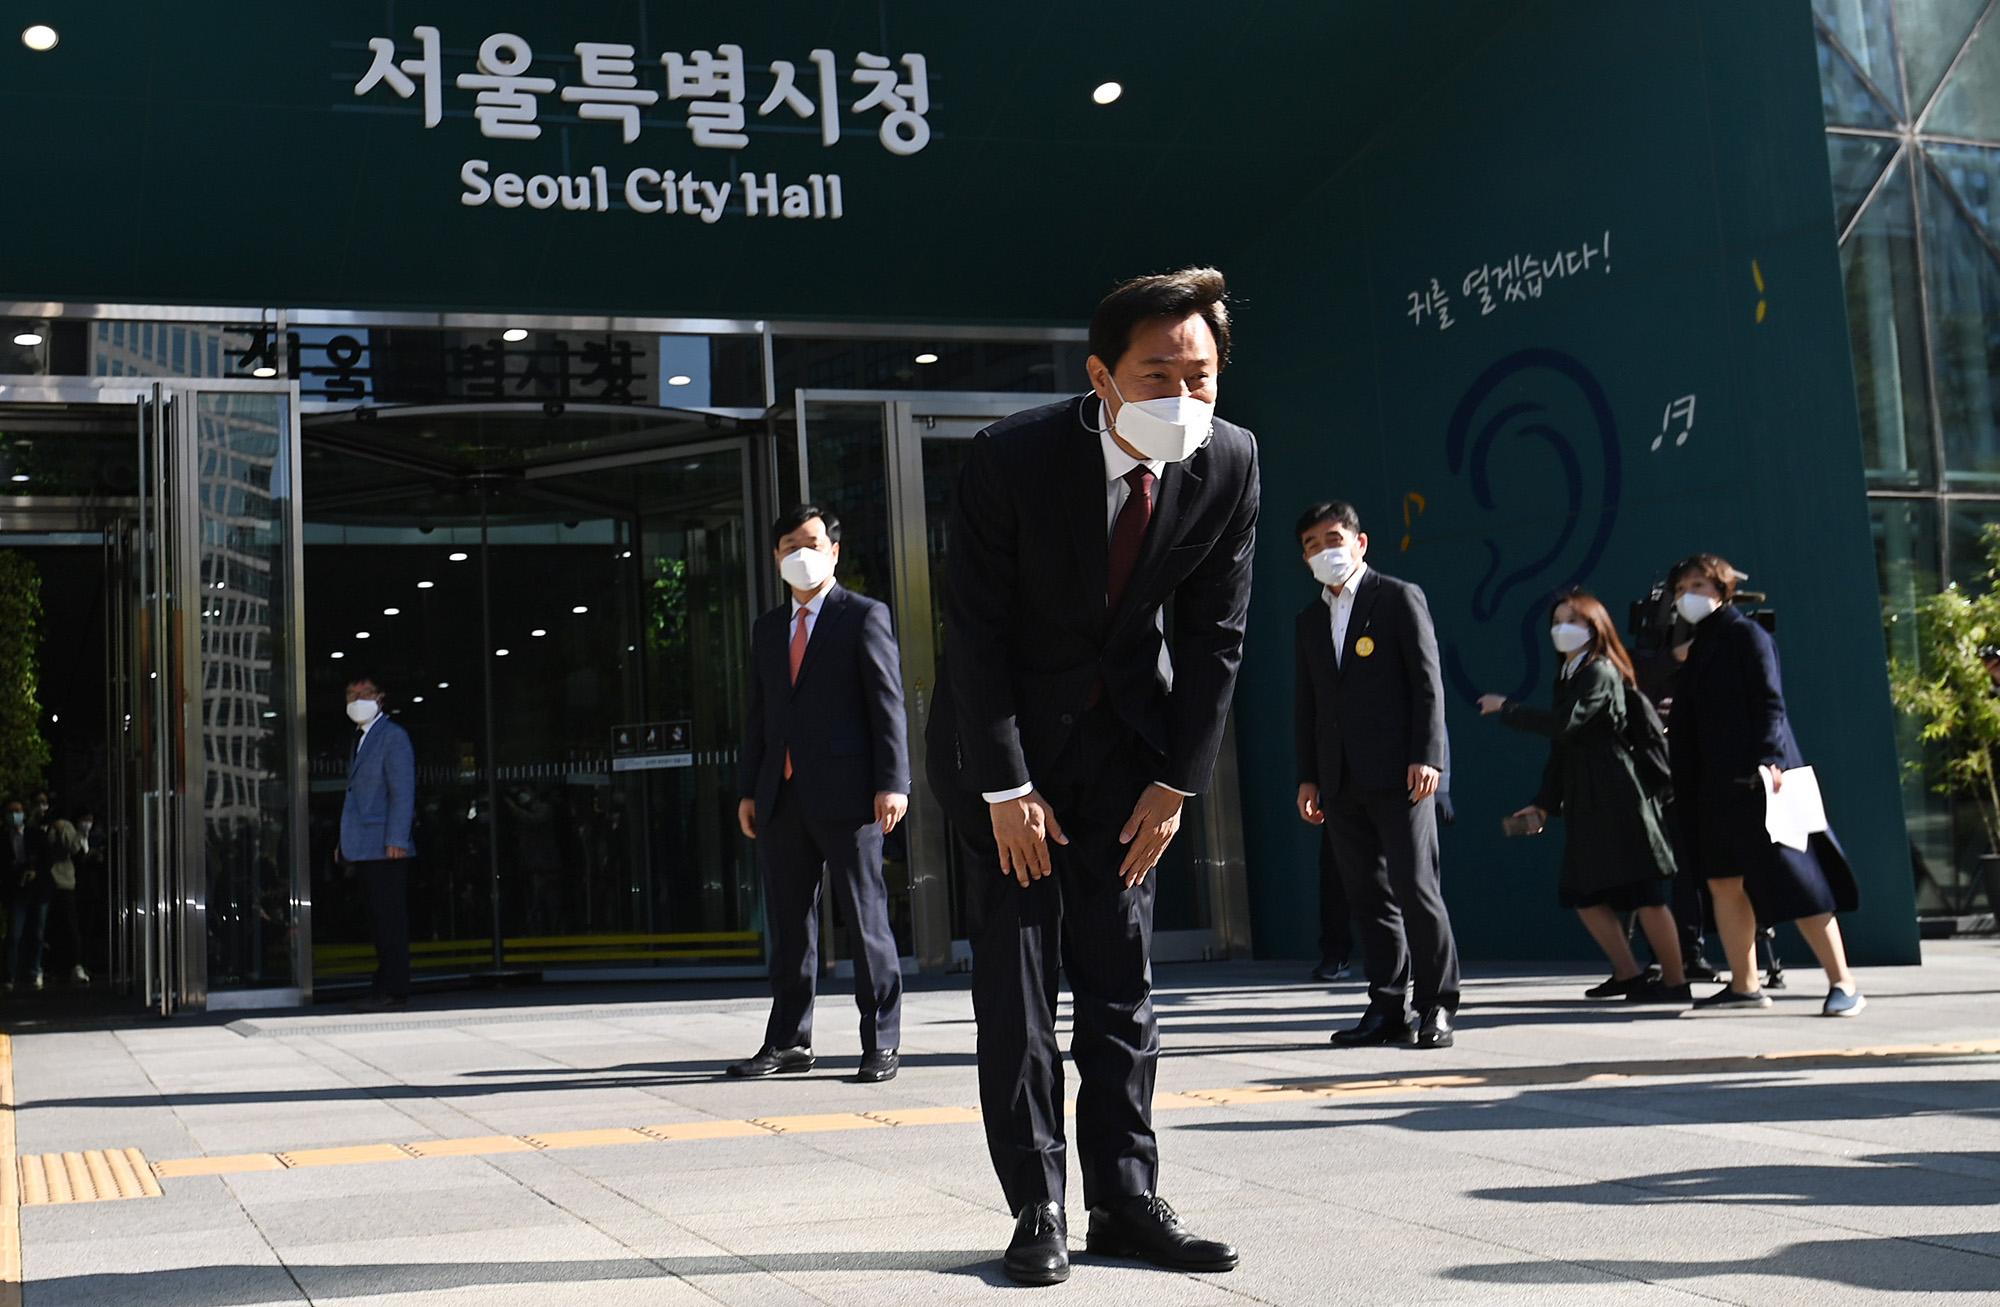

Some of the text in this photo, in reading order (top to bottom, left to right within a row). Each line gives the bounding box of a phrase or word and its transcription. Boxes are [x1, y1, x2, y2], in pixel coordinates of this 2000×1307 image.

[353, 25, 932, 156] 서울특별시청
[460, 159, 844, 223] Seoul City Hall
[1407, 229, 1612, 331] 귀를 열겠습니다!
